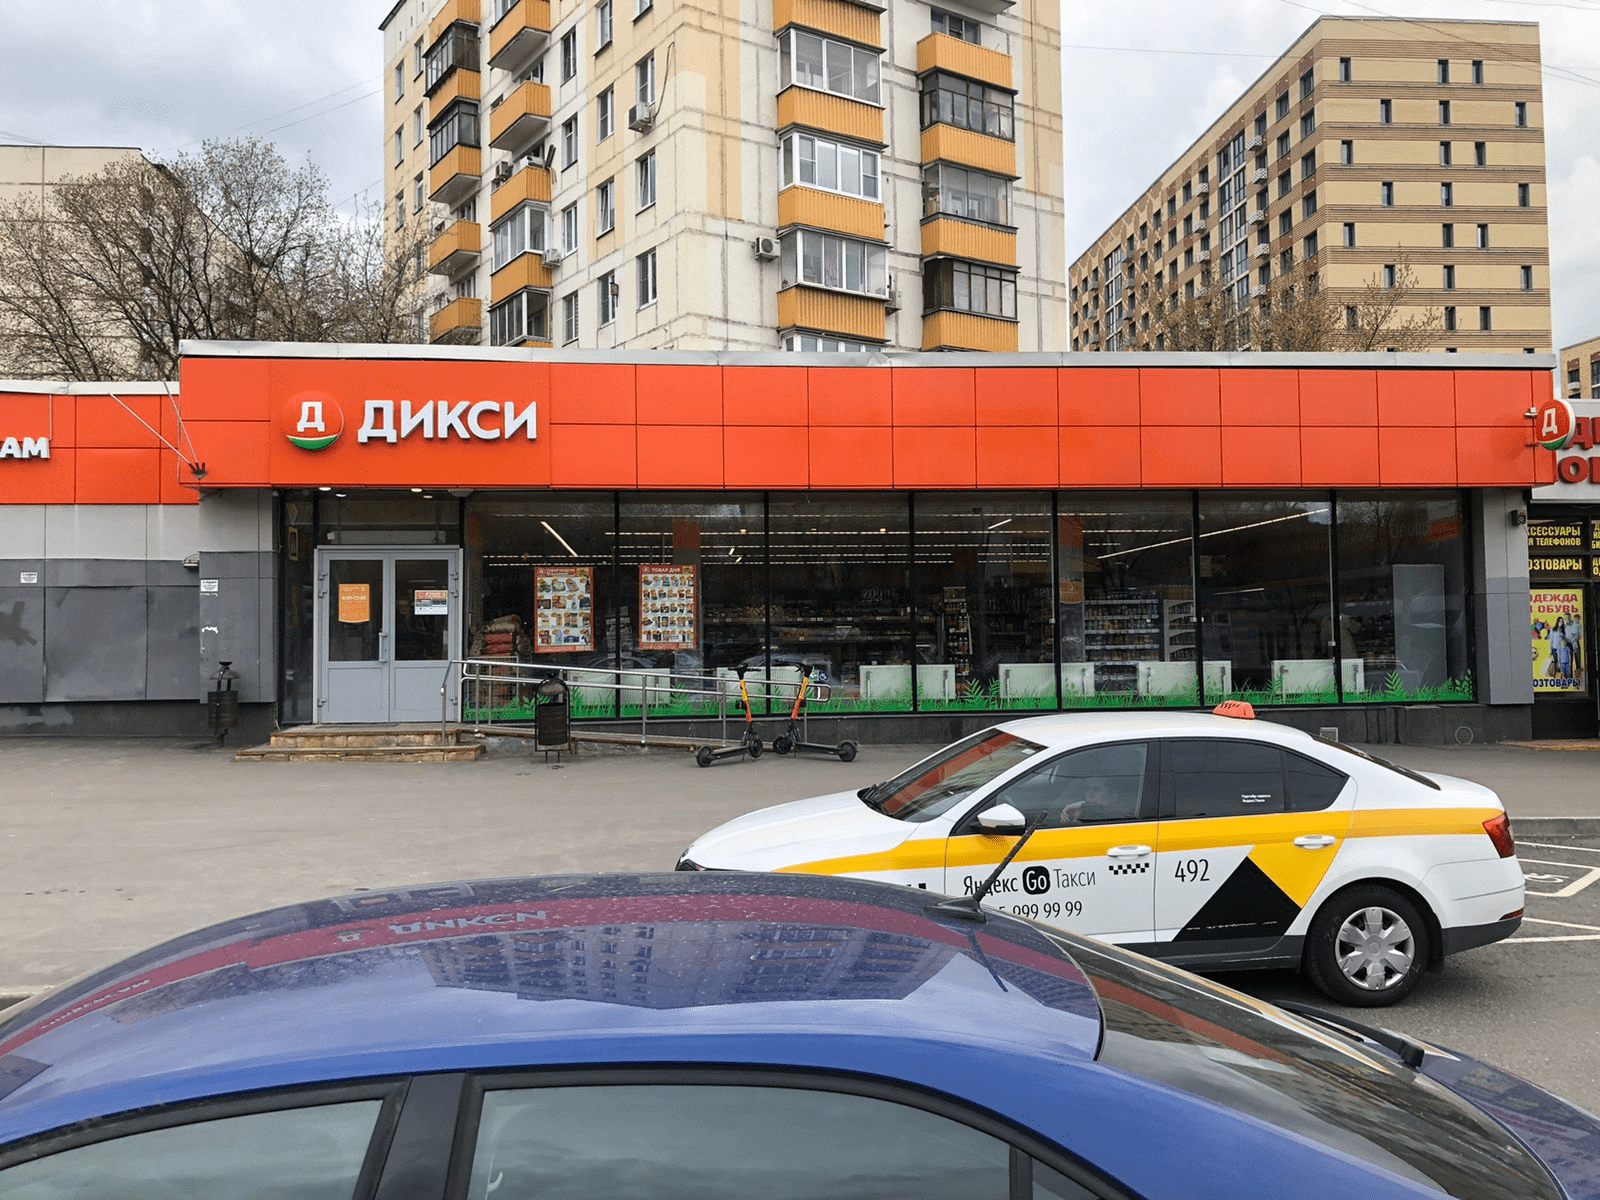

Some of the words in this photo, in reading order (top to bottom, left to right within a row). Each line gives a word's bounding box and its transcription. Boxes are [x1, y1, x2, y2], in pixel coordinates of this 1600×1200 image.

[297, 401, 325, 432] Д
[358, 400, 537, 443] ДИКСИ
[1542, 408, 1558, 437] Д
[1536, 537, 1581, 546] ТЕЛЕФОНОВ
[1538, 605, 1579, 613] ОБУВЬ
[1026, 870, 1047, 891] Go
[1053, 868, 1096, 888] Такси
[1174, 859, 1210, 882] 492
[1043, 902, 1061, 919] 99
[1065, 900, 1083, 917] 99
